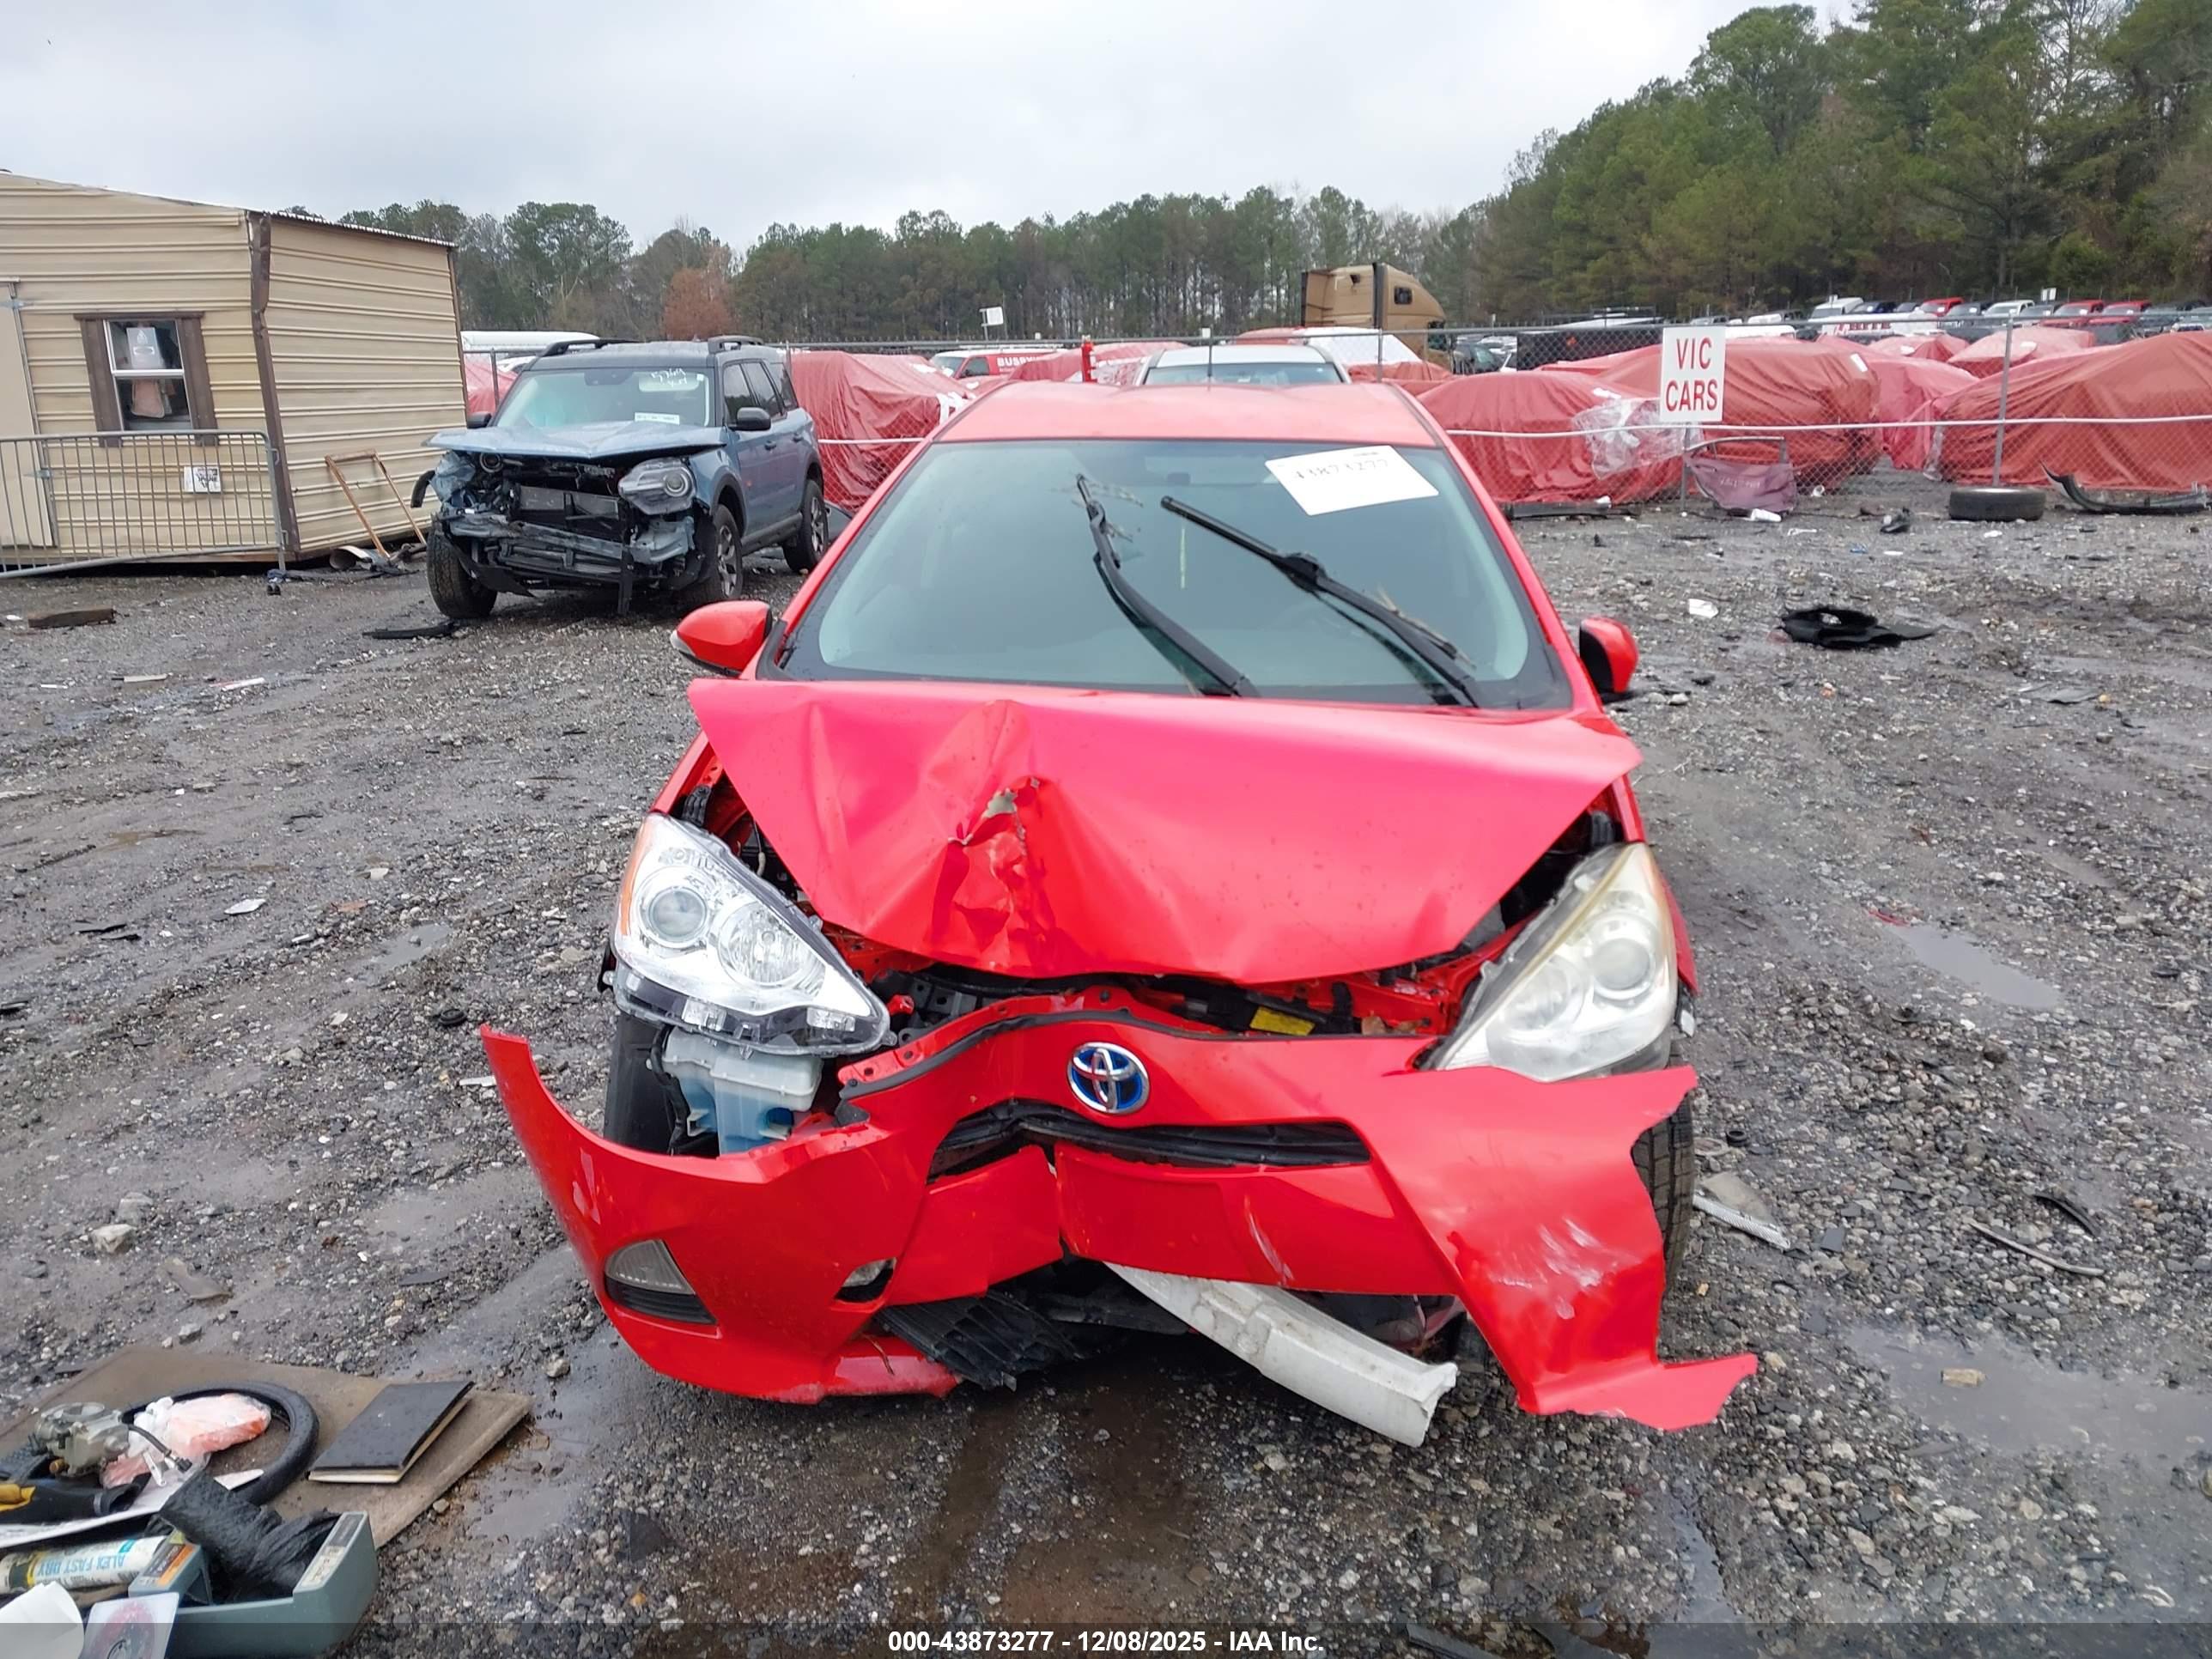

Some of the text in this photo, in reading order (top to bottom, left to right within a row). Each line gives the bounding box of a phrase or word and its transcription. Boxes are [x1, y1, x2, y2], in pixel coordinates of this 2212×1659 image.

[1676, 337, 1712, 370] VIC
[1665, 377, 1718, 412] CARS
[38, 1554, 125, 1575] ALEX FAST DRY
